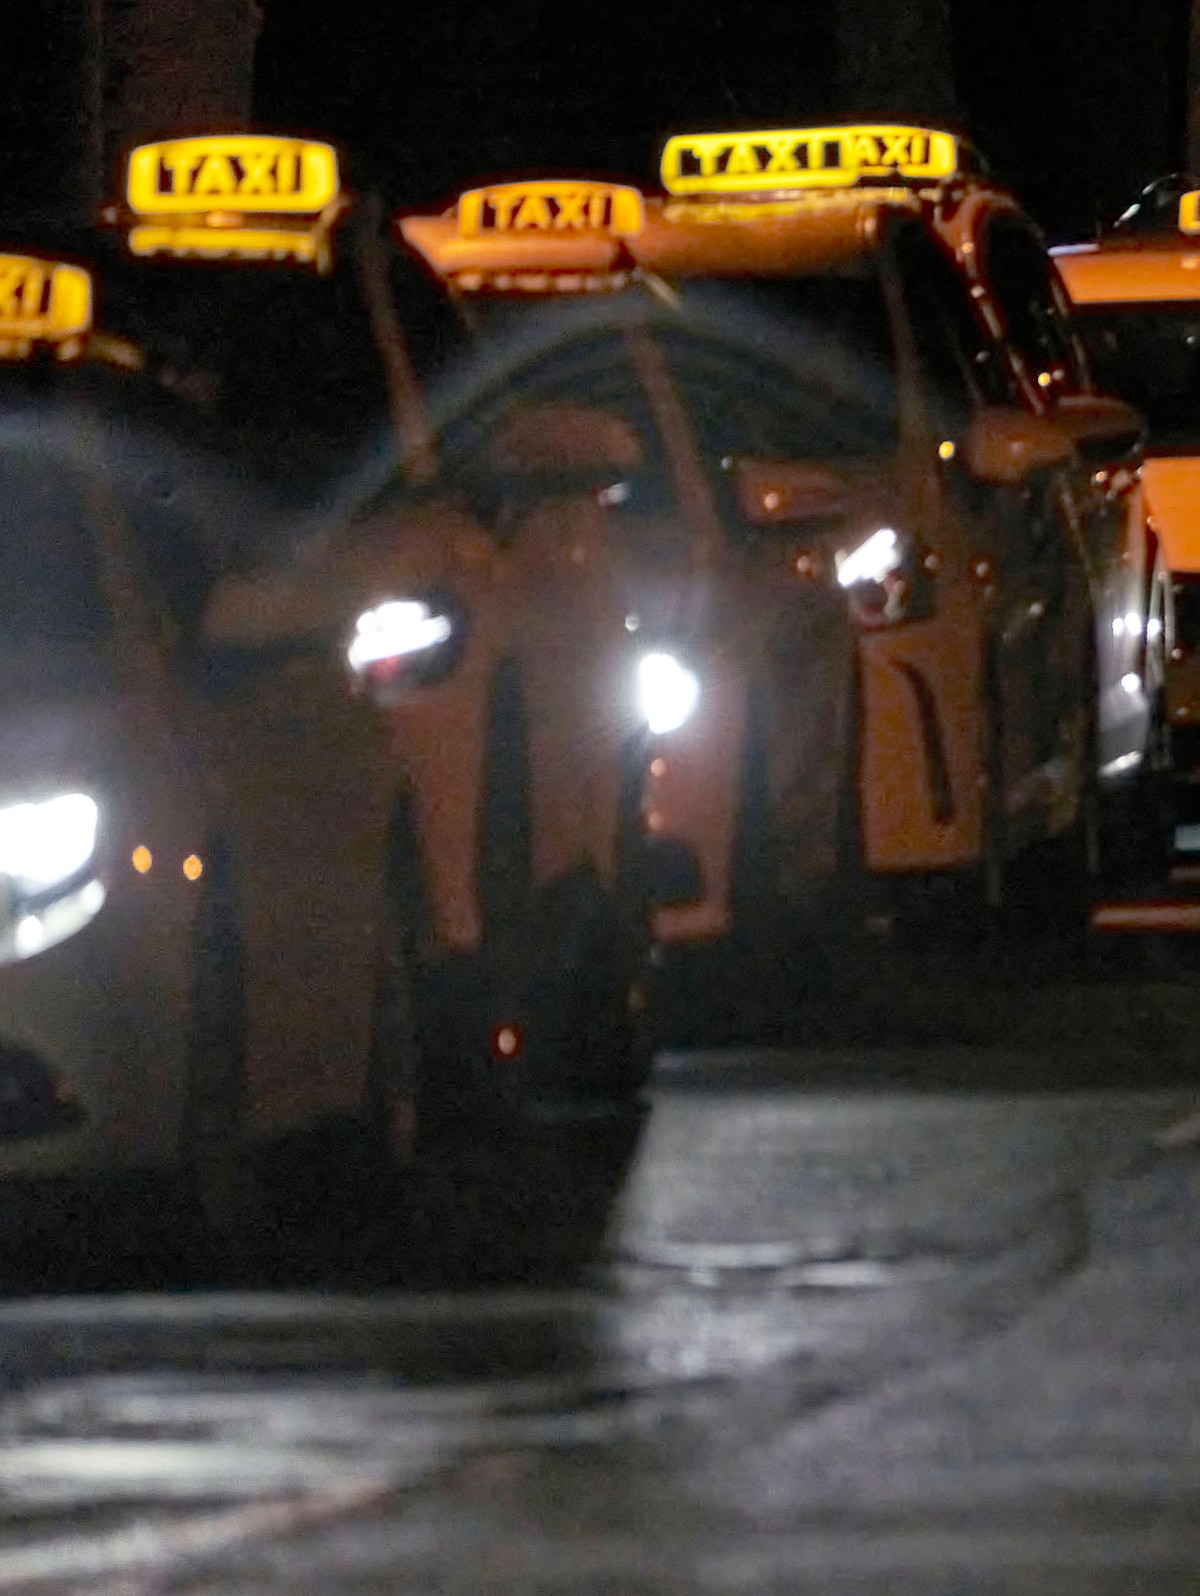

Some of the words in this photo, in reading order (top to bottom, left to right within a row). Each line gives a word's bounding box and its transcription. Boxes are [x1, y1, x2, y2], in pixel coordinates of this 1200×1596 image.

[162, 154, 296, 193] TAXI
[690, 138, 823, 174] TAXI
[487, 194, 605, 228] TAXI
